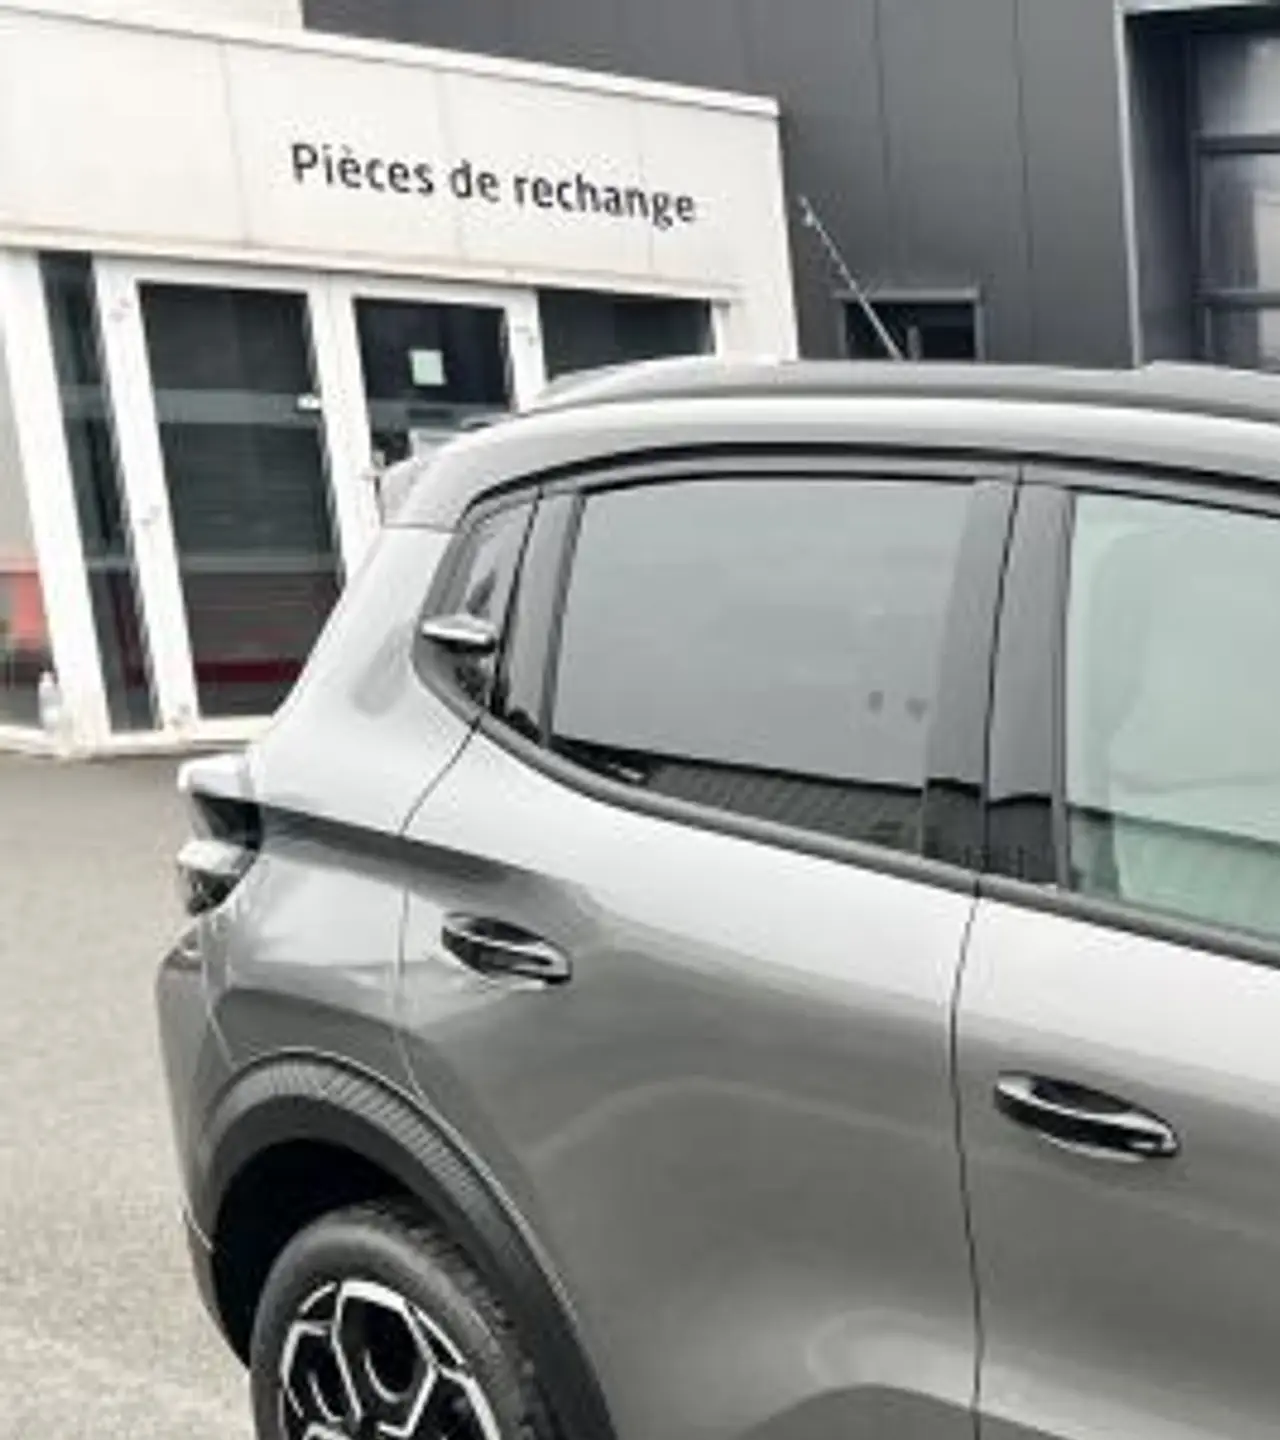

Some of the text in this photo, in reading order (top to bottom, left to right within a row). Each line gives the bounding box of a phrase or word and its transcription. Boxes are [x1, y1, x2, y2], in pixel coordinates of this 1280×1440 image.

[289, 142, 697, 231] Pièces de rechange
